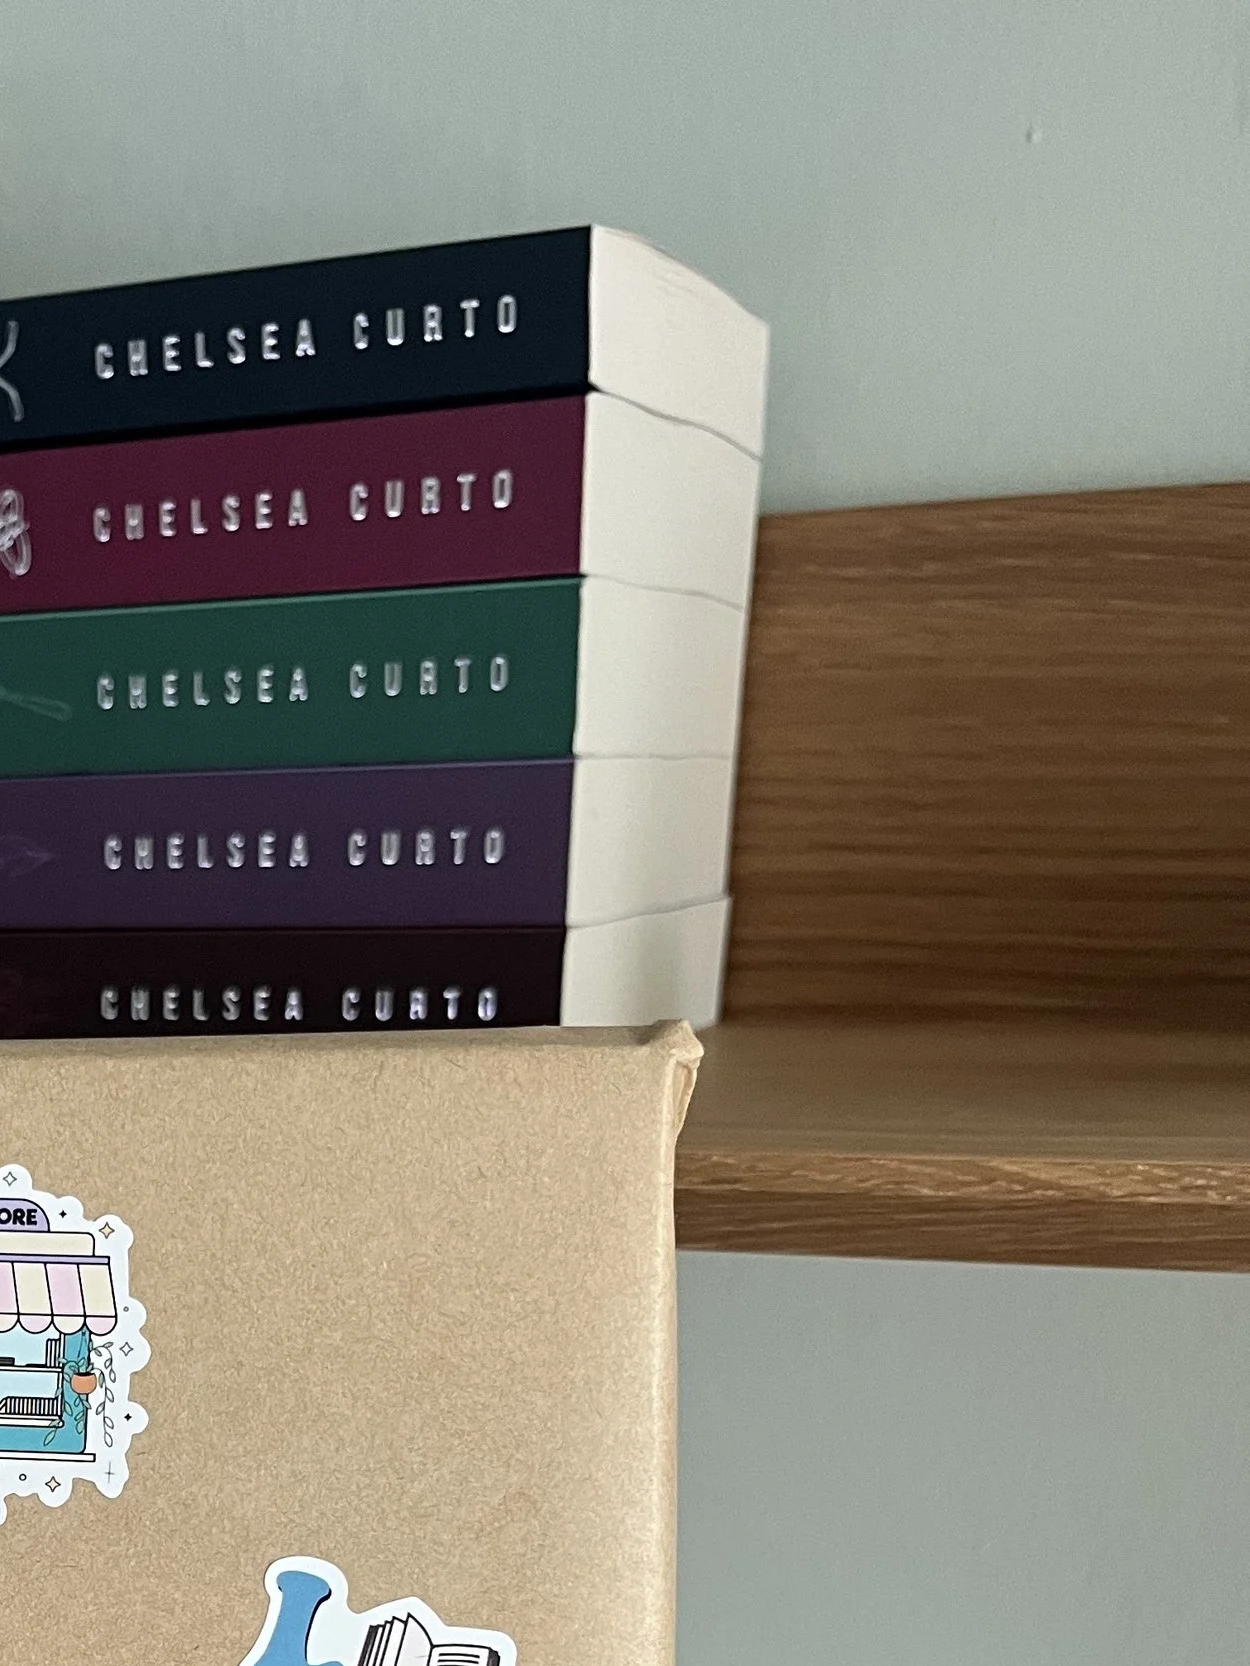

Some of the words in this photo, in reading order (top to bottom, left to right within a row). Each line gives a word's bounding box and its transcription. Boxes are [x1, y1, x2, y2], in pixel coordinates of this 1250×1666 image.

[94, 318, 316, 380] CHELSEA
[352, 294, 518, 351] CURTO
[92, 488, 309, 543] CHELSEA
[348, 468, 514, 522] CURTO
[96, 666, 309, 711] CHELSEA
[348, 652, 511, 700] CURTO
[103, 829, 310, 871] CHELSEA
[346, 826, 506, 867] CURTO
[99, 985, 303, 1022] CHELSEA
[341, 984, 499, 1022] CURTO
